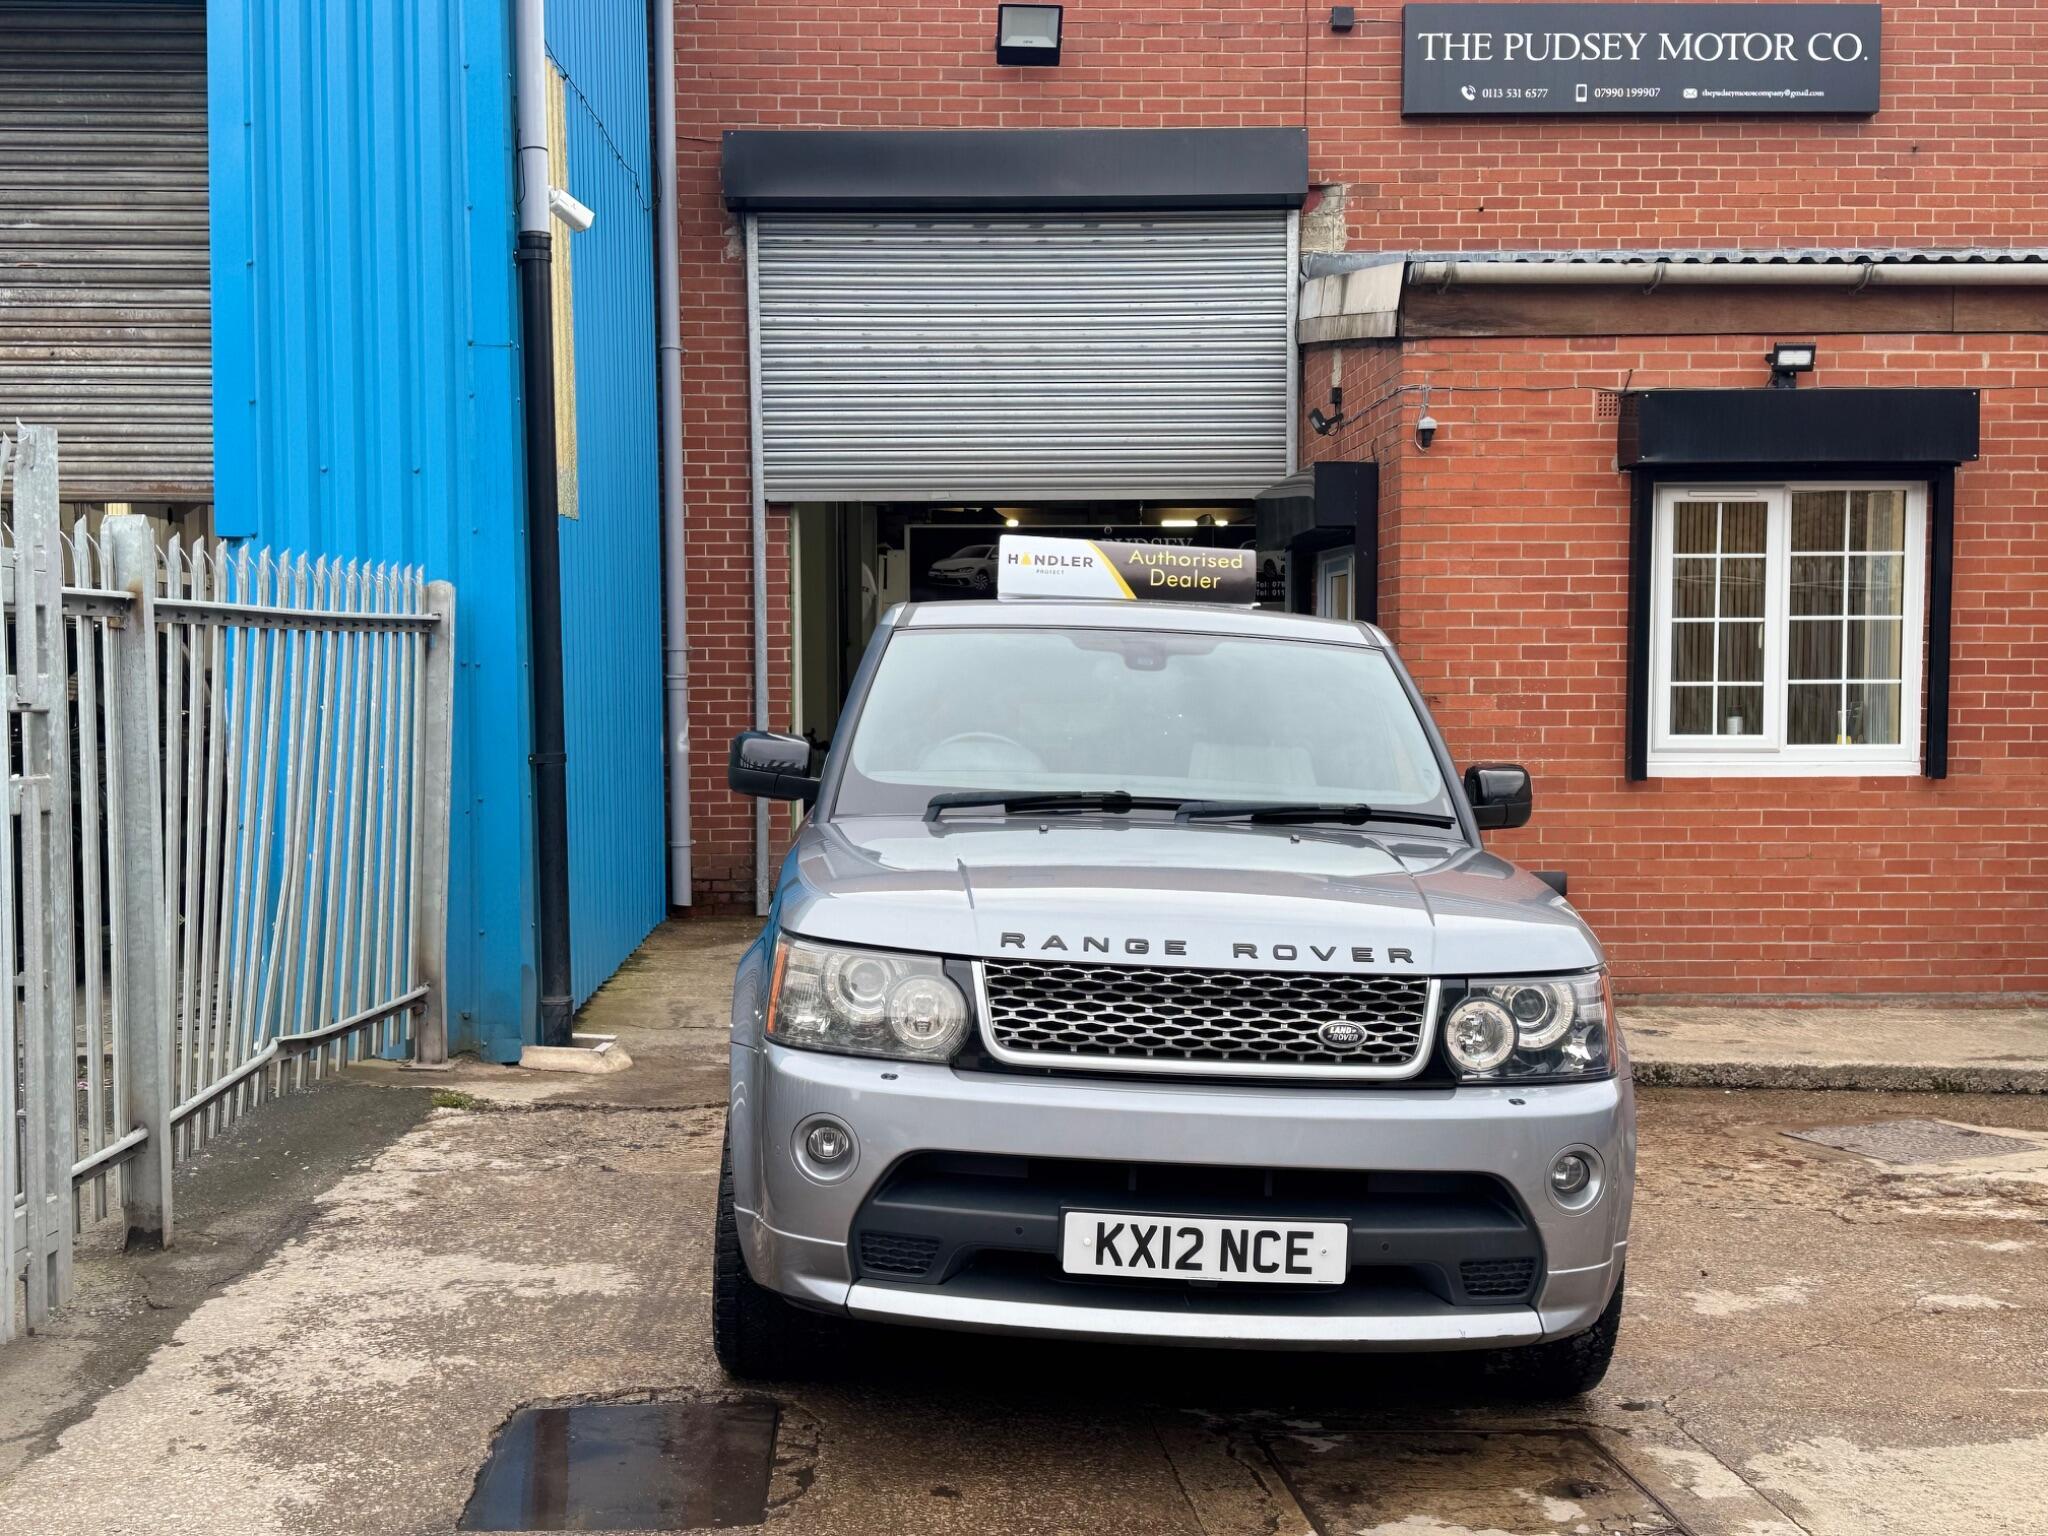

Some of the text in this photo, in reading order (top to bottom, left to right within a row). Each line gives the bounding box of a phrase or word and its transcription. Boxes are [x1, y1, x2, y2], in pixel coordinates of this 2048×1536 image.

[1417, 32, 1869, 62] THE PUDSEY MOTOR CO.
[1481, 87, 1549, 99] 0113 531 6577
[1593, 87, 1661, 99] 07990 199907
[1007, 552, 1094, 568] HANDLER
[1129, 549, 1243, 570] Authorised
[1150, 568, 1222, 590] Dealer
[1000, 932, 1414, 964] RANGE ROVER
[1330, 1026, 1351, 1034] LAND
[1332, 1033, 1358, 1041] ROVER
[1095, 1221, 1314, 1275] KX12 NCE
